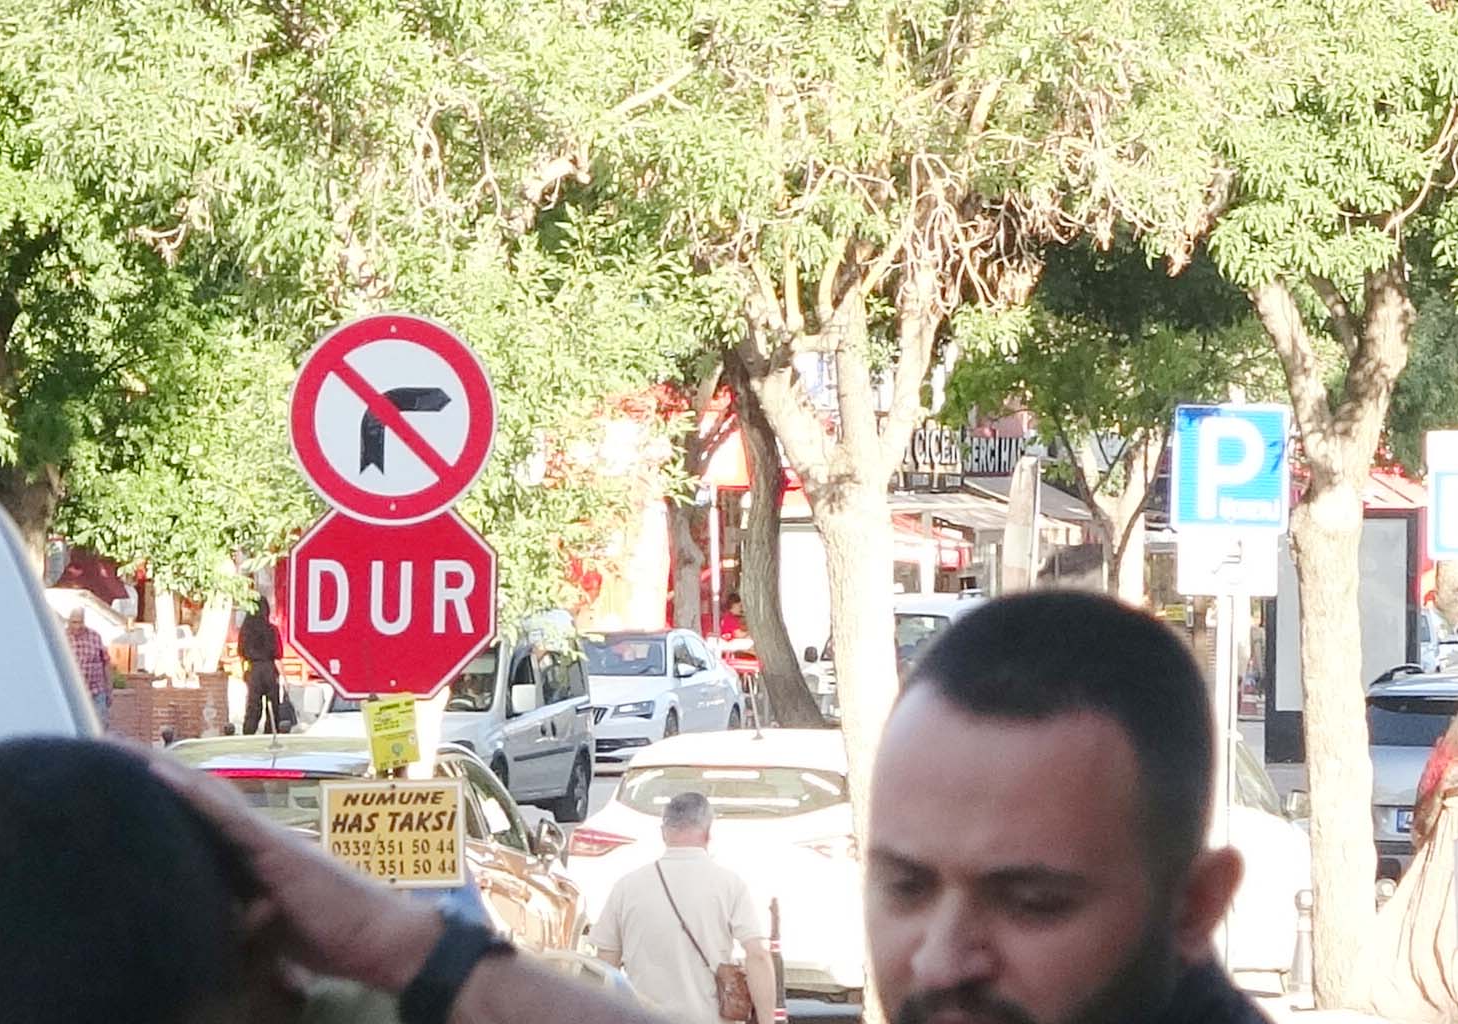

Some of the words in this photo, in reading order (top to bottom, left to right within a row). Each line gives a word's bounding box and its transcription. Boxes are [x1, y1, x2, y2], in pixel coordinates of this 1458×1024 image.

[1198, 416, 1265, 519] P
[307, 558, 475, 636] DUR
[343, 791, 445, 807] NUMUNE
[332, 812, 380, 833] HAS
[388, 804, 458, 833] TAKSİ
[412, 838, 431, 855] 50
[437, 838, 455, 854] 44
[378, 860, 405, 876] 351
[413, 859, 432, 875] 50
[438, 859, 456, 875] 44
